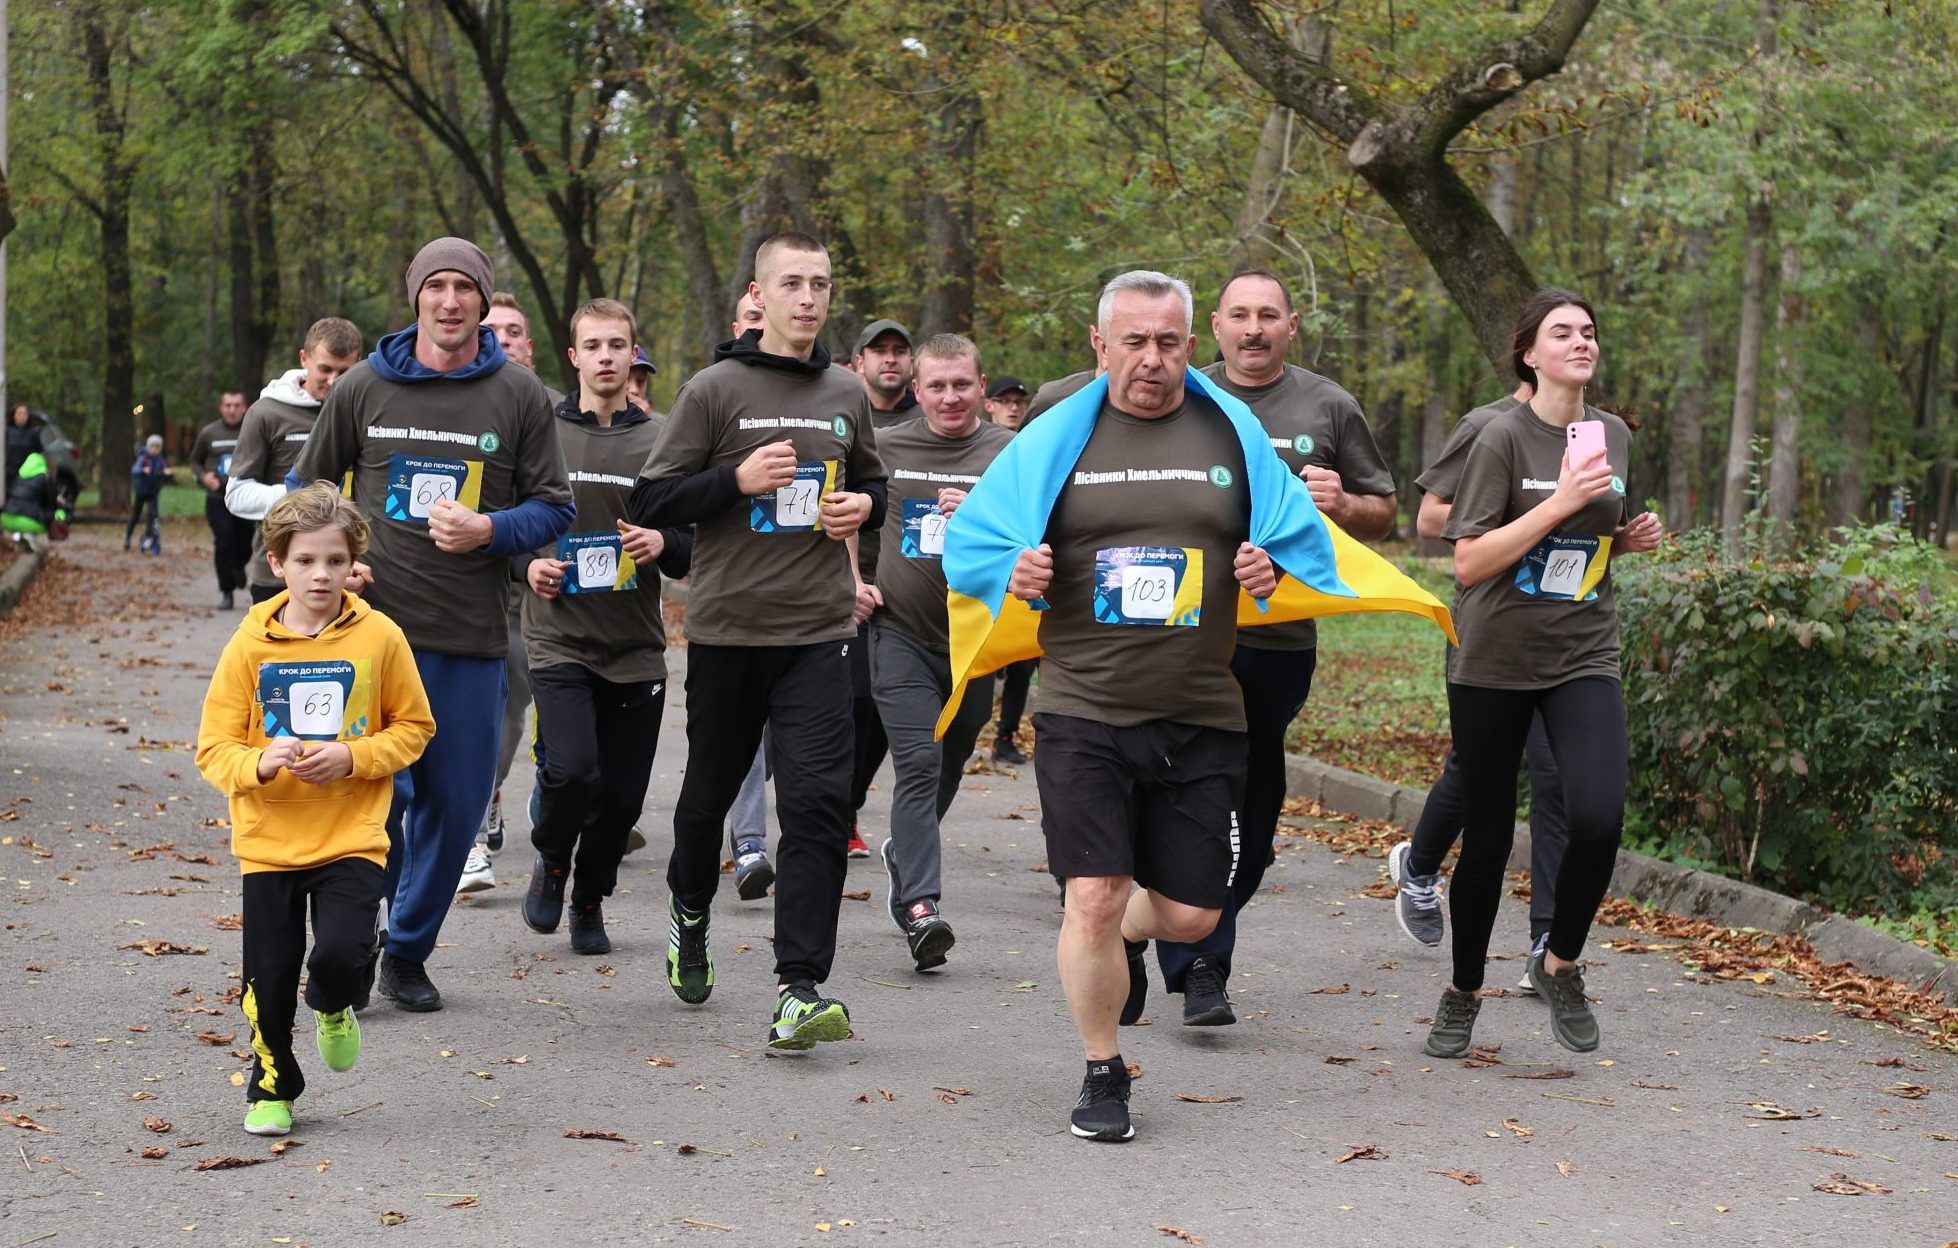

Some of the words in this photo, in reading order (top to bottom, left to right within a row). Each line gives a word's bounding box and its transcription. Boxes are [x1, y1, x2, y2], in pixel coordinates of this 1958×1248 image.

[739, 417, 779, 430] Лісівники
[779, 417, 832, 431] Хмельниччини
[367, 425, 408, 439] Лісівники
[408, 427, 478, 446] Хмельниччини
[423, 461, 432, 469] ДО
[433, 462, 466, 471] ПЕРЕМОГИ
[577, 470, 635, 488] Хмельниччини
[1073, 470, 1126, 486] Лісівники
[1127, 468, 1208, 483] Хмельниччини
[417, 480, 452, 505] 68
[784, 486, 812, 515] 71
[585, 553, 609, 578] 89
[1135, 552, 1146, 561] ДО
[1146, 552, 1184, 560] ПЕРЕМОГИ
[1549, 558, 1578, 580] 101
[1128, 577, 1167, 602] 103
[278, 667, 299, 675] КРОК
[300, 667, 312, 675] ДО
[312, 666, 352, 674] ПЕРЕМОГИ
[304, 693, 332, 716] 63
